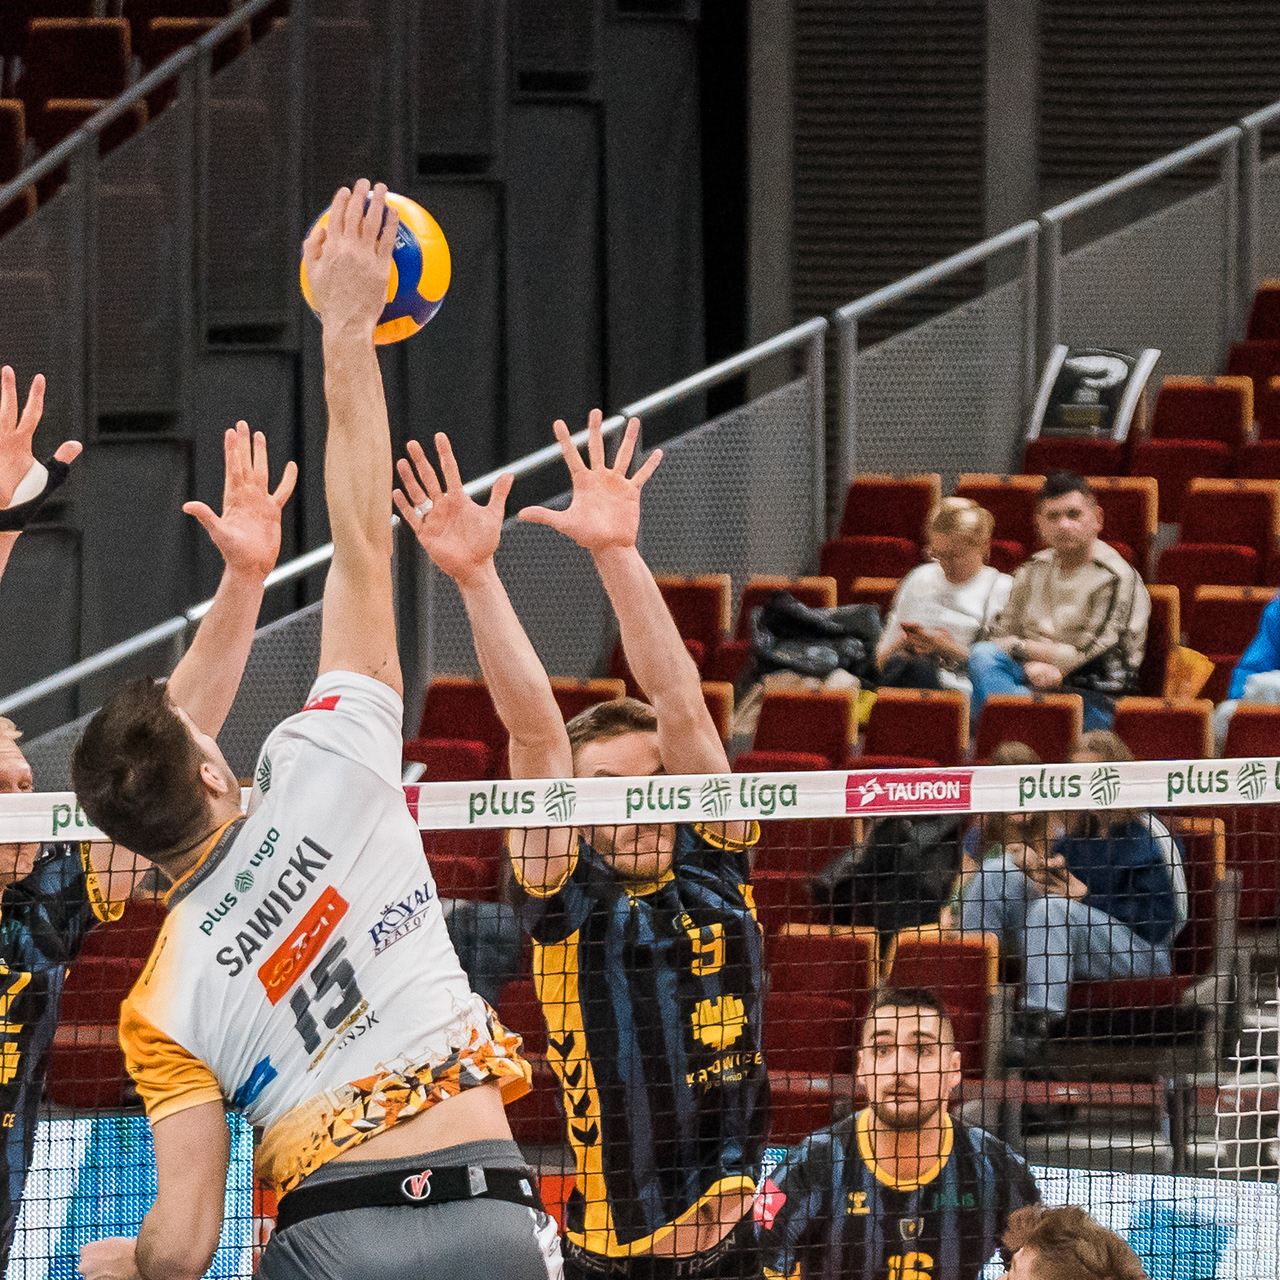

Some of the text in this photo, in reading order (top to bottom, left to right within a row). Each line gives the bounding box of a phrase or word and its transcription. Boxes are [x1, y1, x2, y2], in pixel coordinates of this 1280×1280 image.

[468, 783, 535, 823] plus
[625, 777, 798, 818] plus liga
[885, 780, 961, 803] TAURON
[1019, 766, 1081, 808] plus
[1166, 762, 1229, 803] plus
[52, 801, 94, 836] pl
[199, 892, 238, 936] plus
[215, 836, 334, 977] SAWICKI
